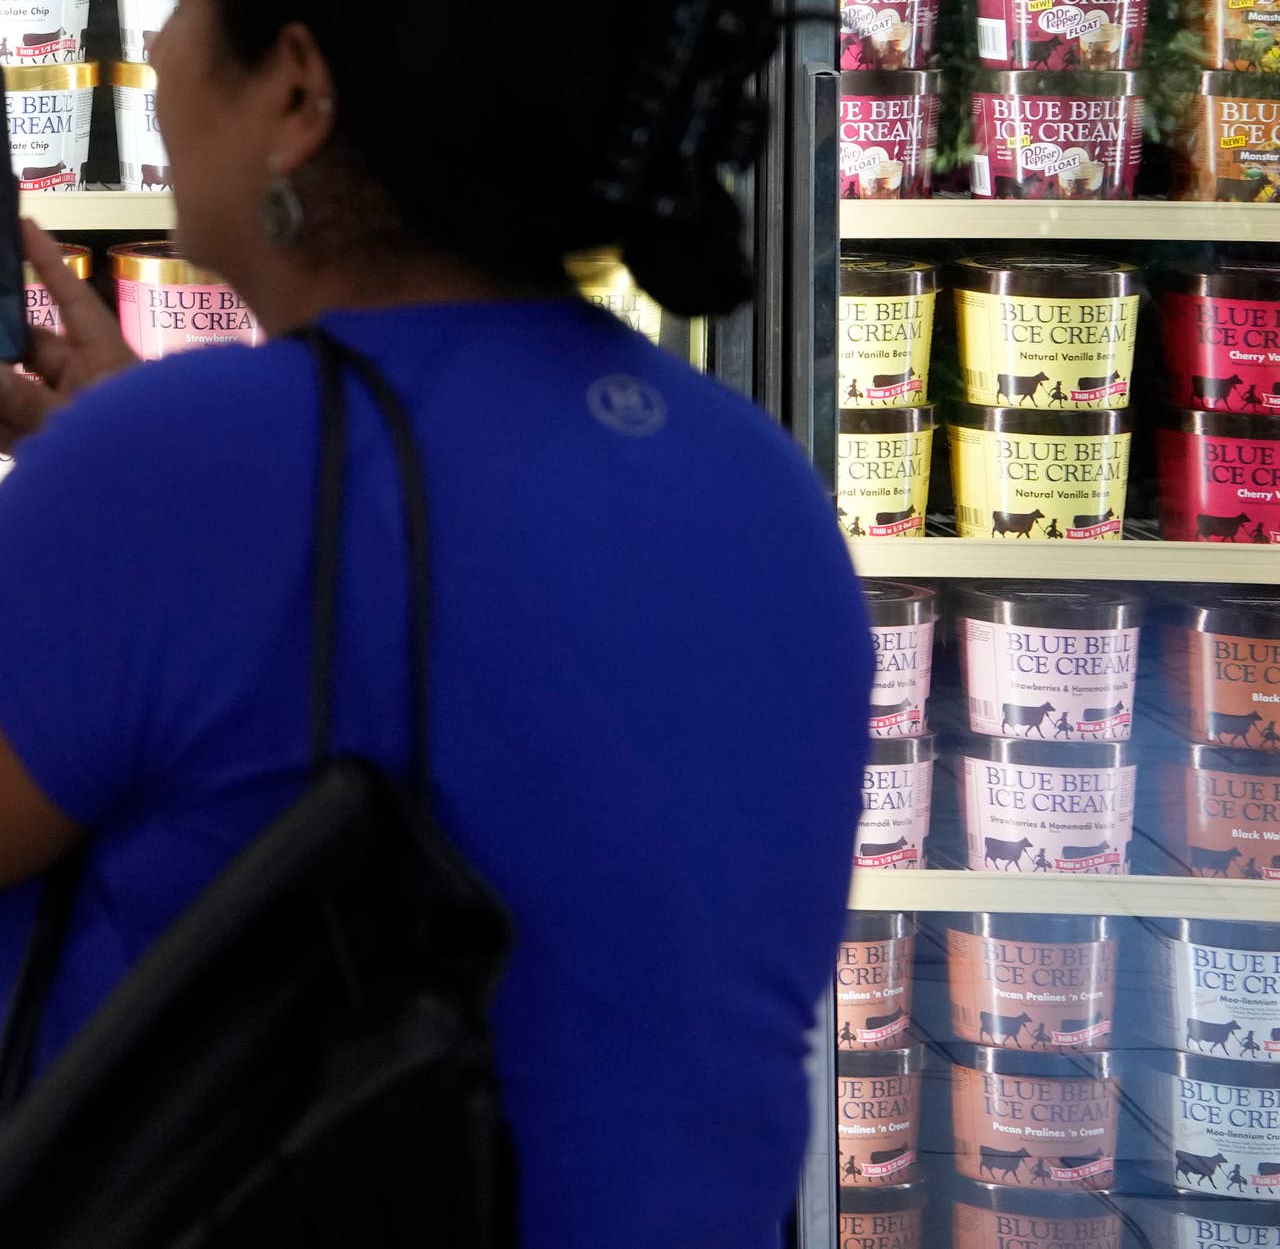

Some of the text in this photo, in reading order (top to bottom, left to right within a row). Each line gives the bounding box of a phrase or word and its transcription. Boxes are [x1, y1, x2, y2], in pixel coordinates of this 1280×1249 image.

[1030, 0, 1051, 10] NEW!
[1057, 9, 1070, 18] Dr
[1046, 12, 1079, 30] Pepper
[1069, 20, 1098, 38] FLOAT
[1020, 352, 1093, 362] Natural Vanilla
[993, 1122, 1022, 1134] Pecan
[1025, 1127, 1065, 1137] Pralines
[1080, 1128, 1104, 1136] Cream
